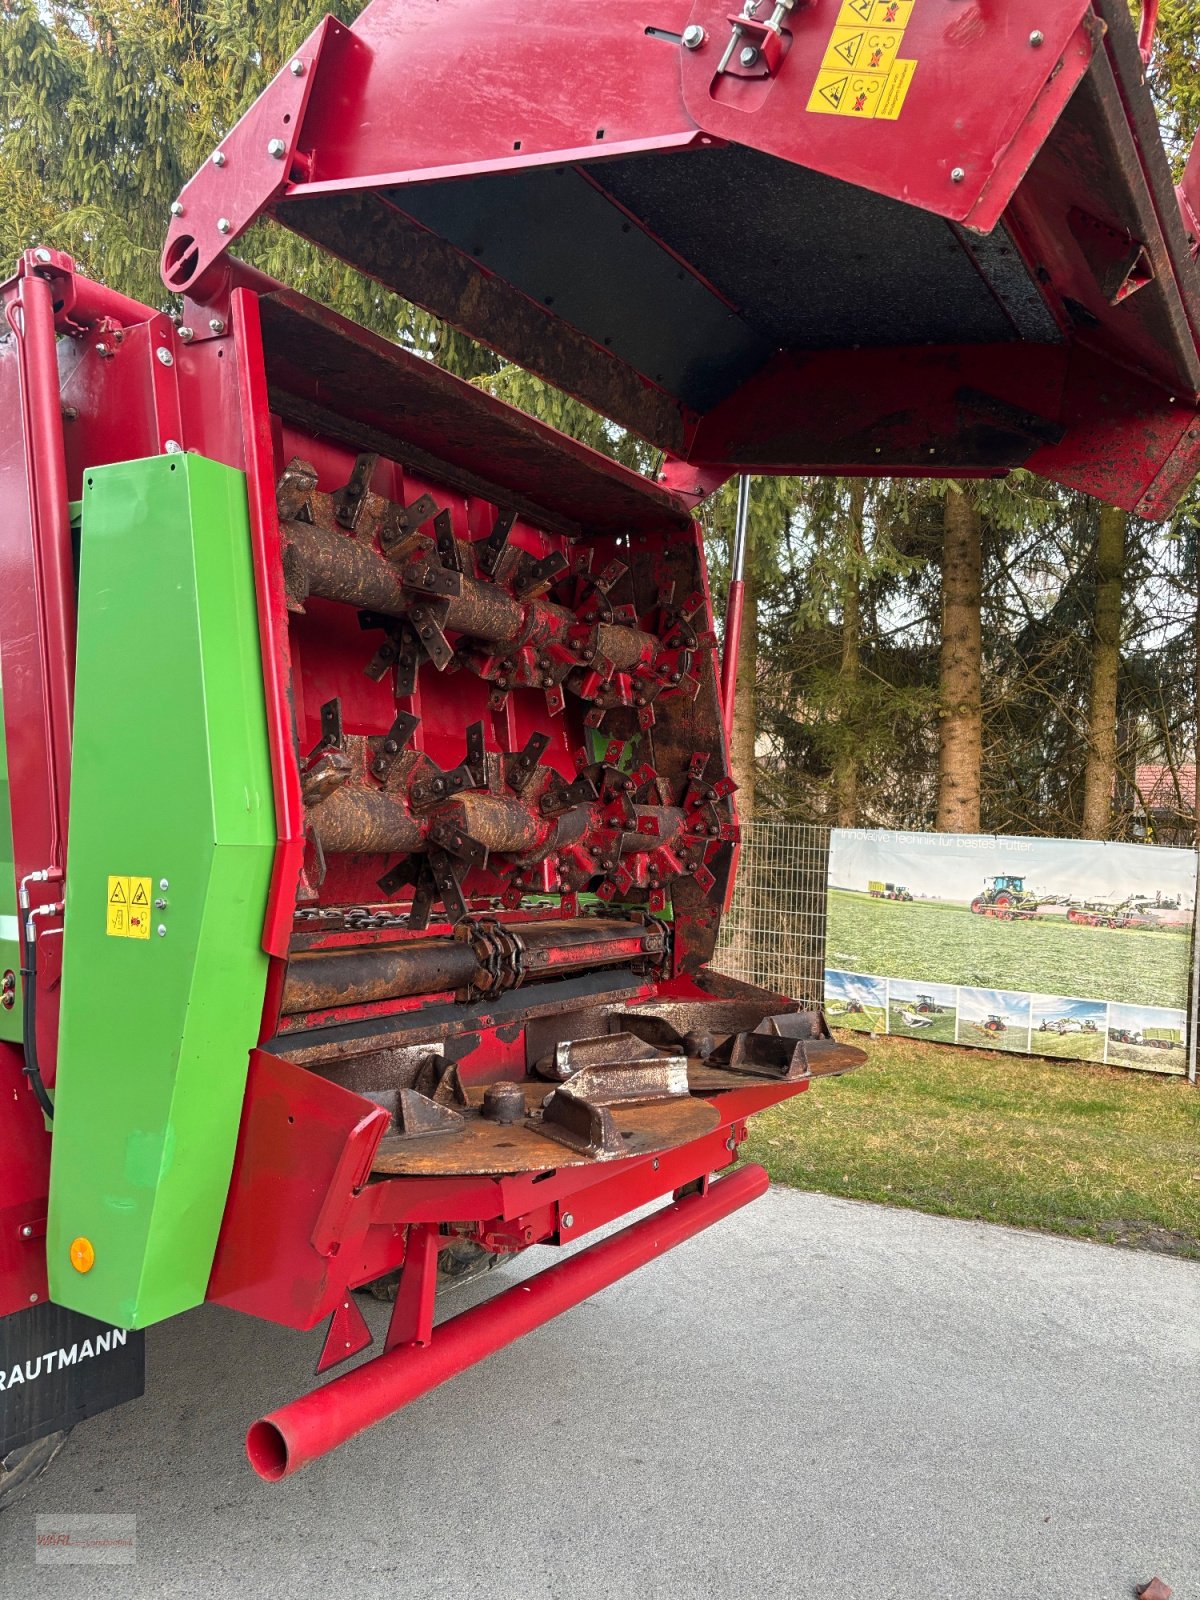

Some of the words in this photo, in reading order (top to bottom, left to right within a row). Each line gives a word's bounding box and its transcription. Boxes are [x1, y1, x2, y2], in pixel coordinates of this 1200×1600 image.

[895, 832, 935, 845] Technik
[939, 835, 953, 847] für
[956, 836, 996, 849] bestes
[1000, 839, 1035, 852] Futter.
